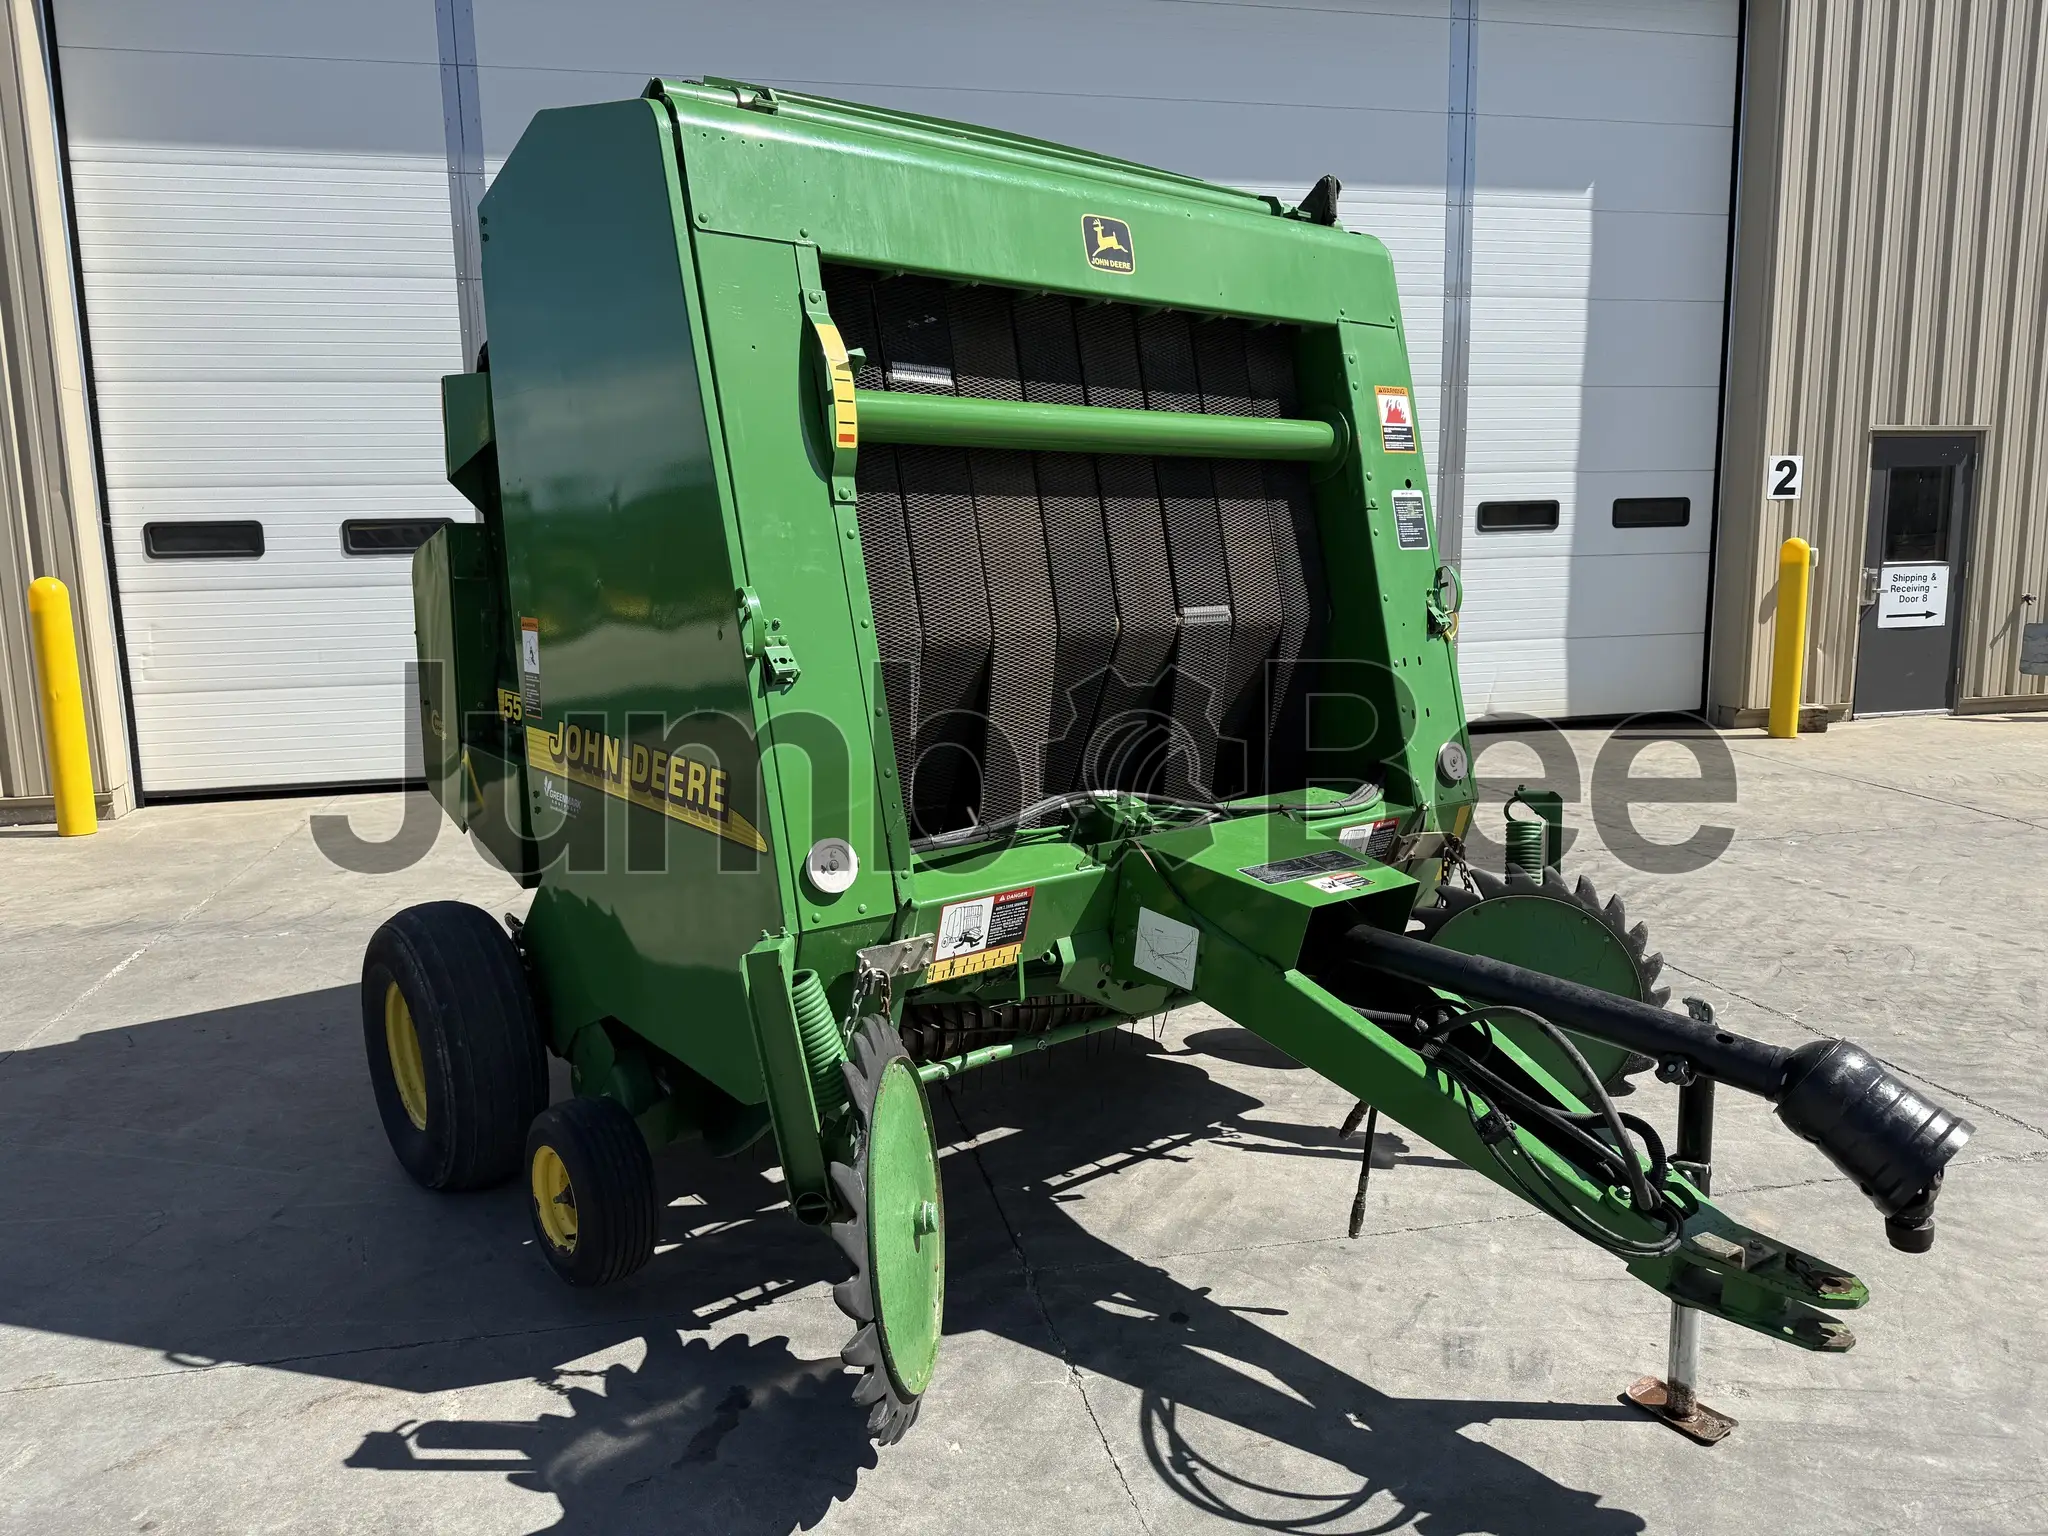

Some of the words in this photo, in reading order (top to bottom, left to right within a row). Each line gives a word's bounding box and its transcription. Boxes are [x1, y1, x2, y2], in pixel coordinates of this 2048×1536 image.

[1091, 256, 1110, 267] JOHN
[1109, 259, 1132, 270] DEERE
[1772, 459, 1798, 496] 2
[1892, 573, 1928, 583] Shipping
[1930, 572, 1937, 581] &
[1890, 584, 1930, 594] Receiving
[1898, 594, 1919, 603] Door
[1921, 594, 1928, 603] 8
[549, 720, 621, 777] JOHN
[630, 742, 728, 813] DEERE
[1006, 891, 1028, 900] DANGER
